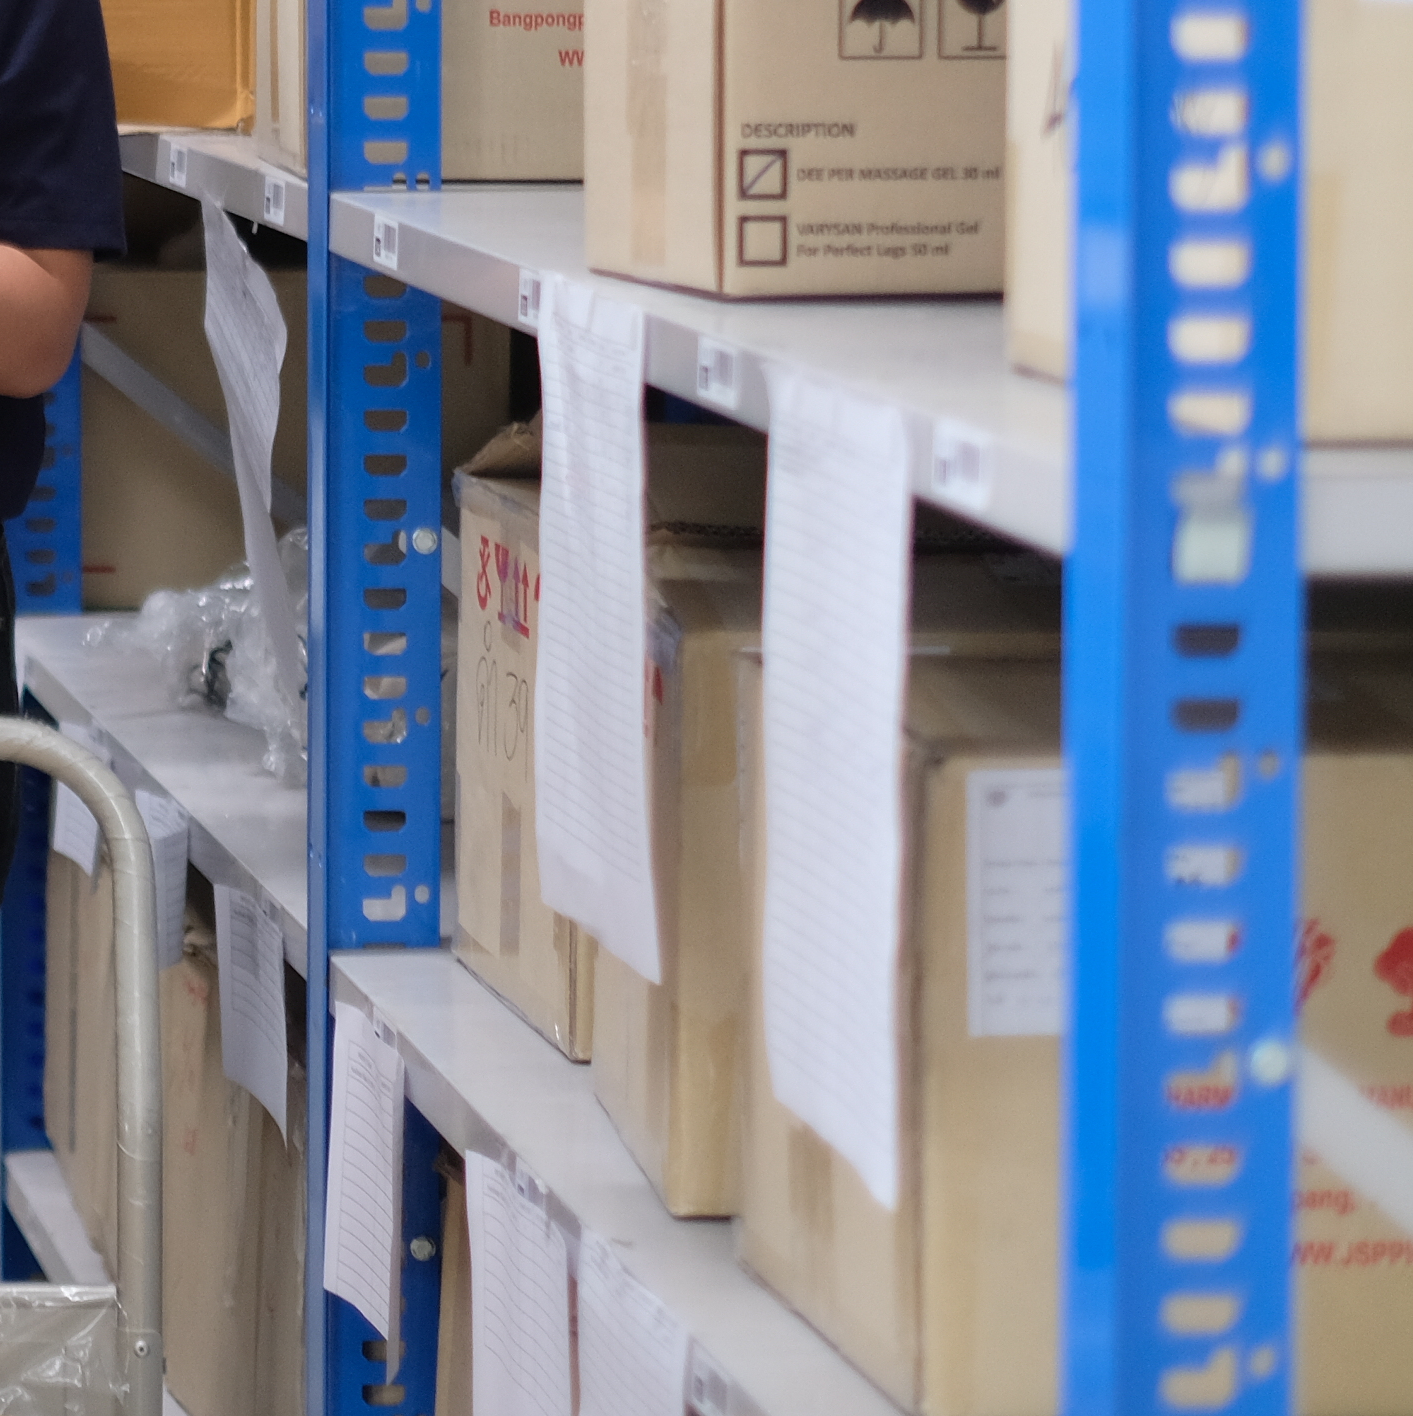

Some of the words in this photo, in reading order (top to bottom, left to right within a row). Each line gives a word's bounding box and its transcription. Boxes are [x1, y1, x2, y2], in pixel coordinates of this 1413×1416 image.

[741, 122, 857, 139] DESCRIPTION
[797, 166, 823, 181] DEE
[827, 166, 855, 182] PER
[857, 166, 929, 182] MASSAGE
[931, 166, 959, 181] GEL
[982, 165, 1001, 181] ml
[796, 221, 863, 237] VARYSAN
[866, 221, 953, 237] Professional
[954, 221, 980, 236] Gel
[796, 243, 820, 258] For
[823, 242, 873, 258] Perfect
[876, 243, 907, 262] Legs
